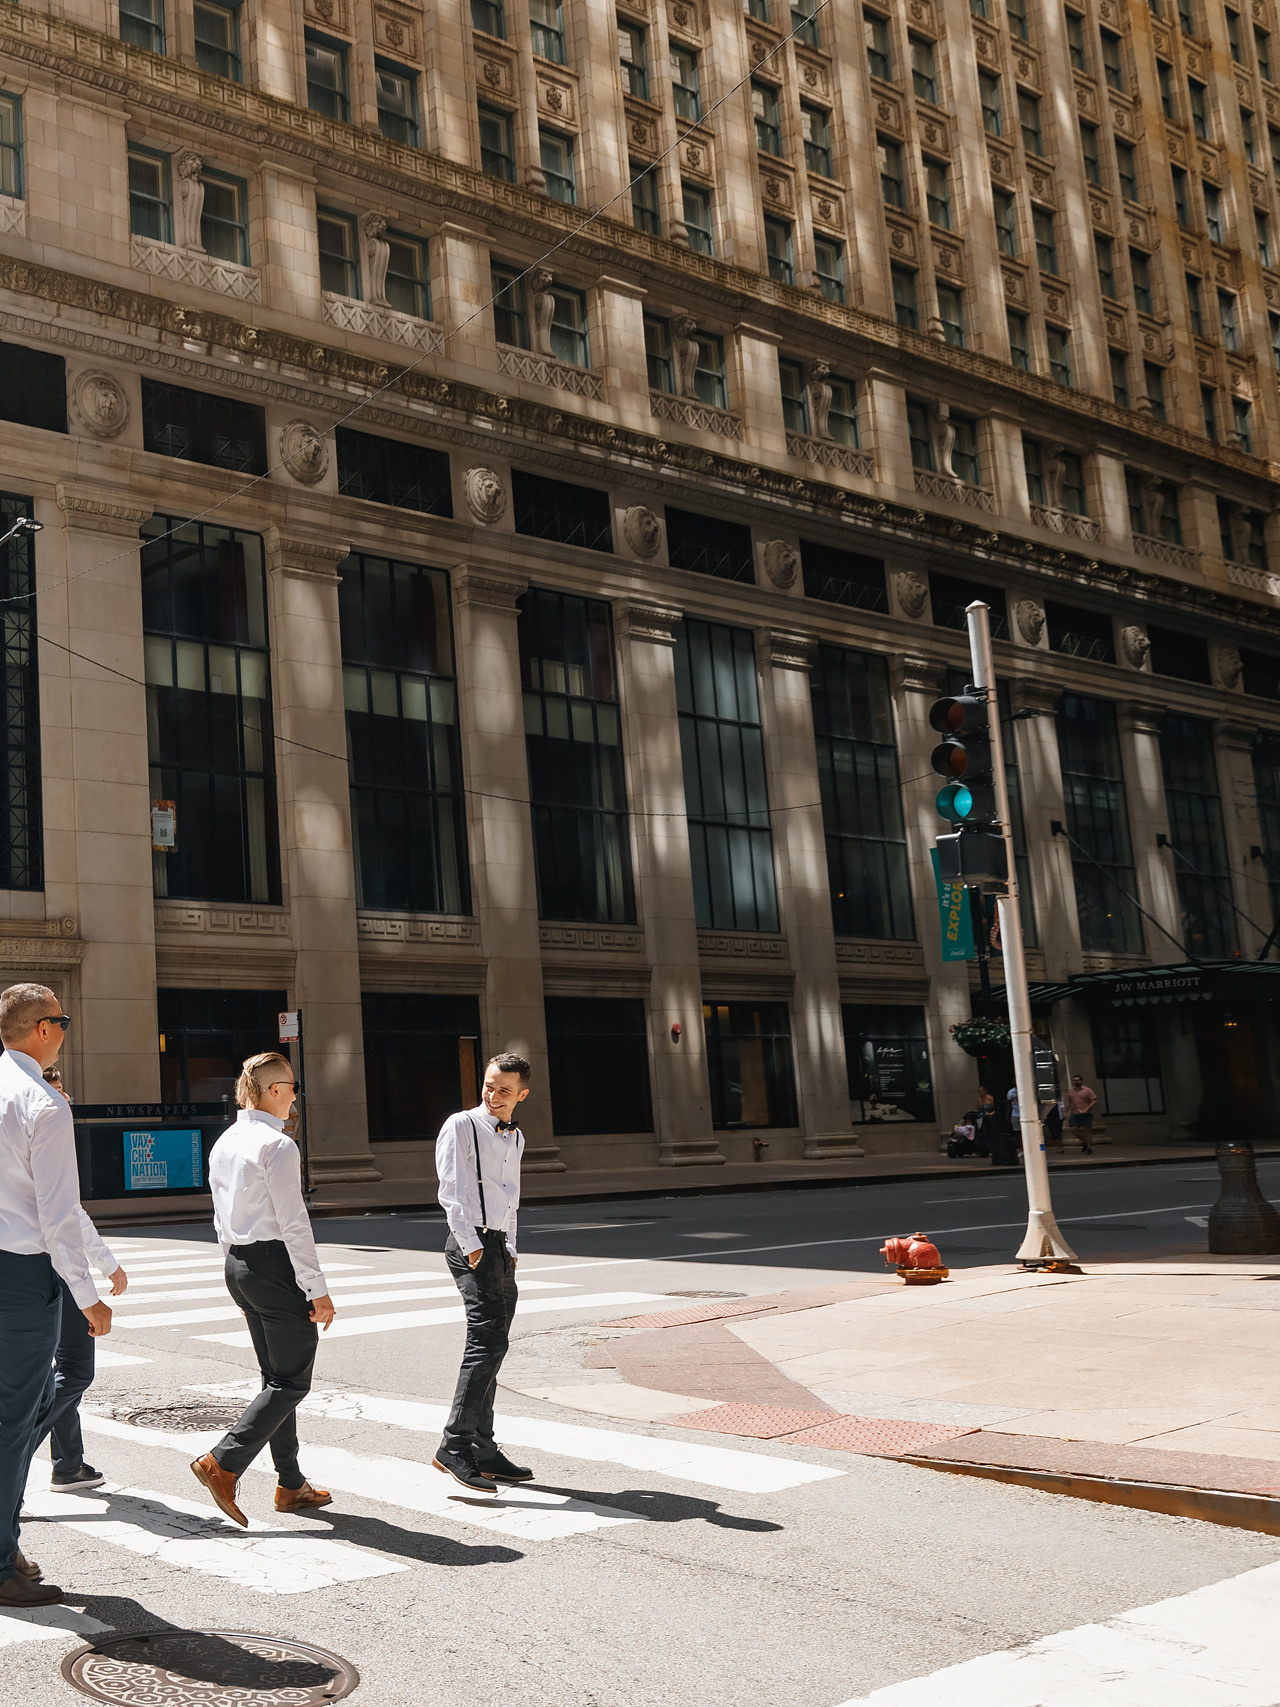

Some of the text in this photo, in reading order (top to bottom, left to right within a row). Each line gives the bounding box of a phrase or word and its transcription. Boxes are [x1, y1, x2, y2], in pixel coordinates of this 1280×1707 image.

[946, 883, 963, 941] EXPLOR
[1114, 976, 1201, 993] JW MARRIOTT
[106, 1104, 198, 1117] NEWSPAPERS
[131, 1134, 151, 1149] VAX
[131, 1162, 166, 1177] NATION
